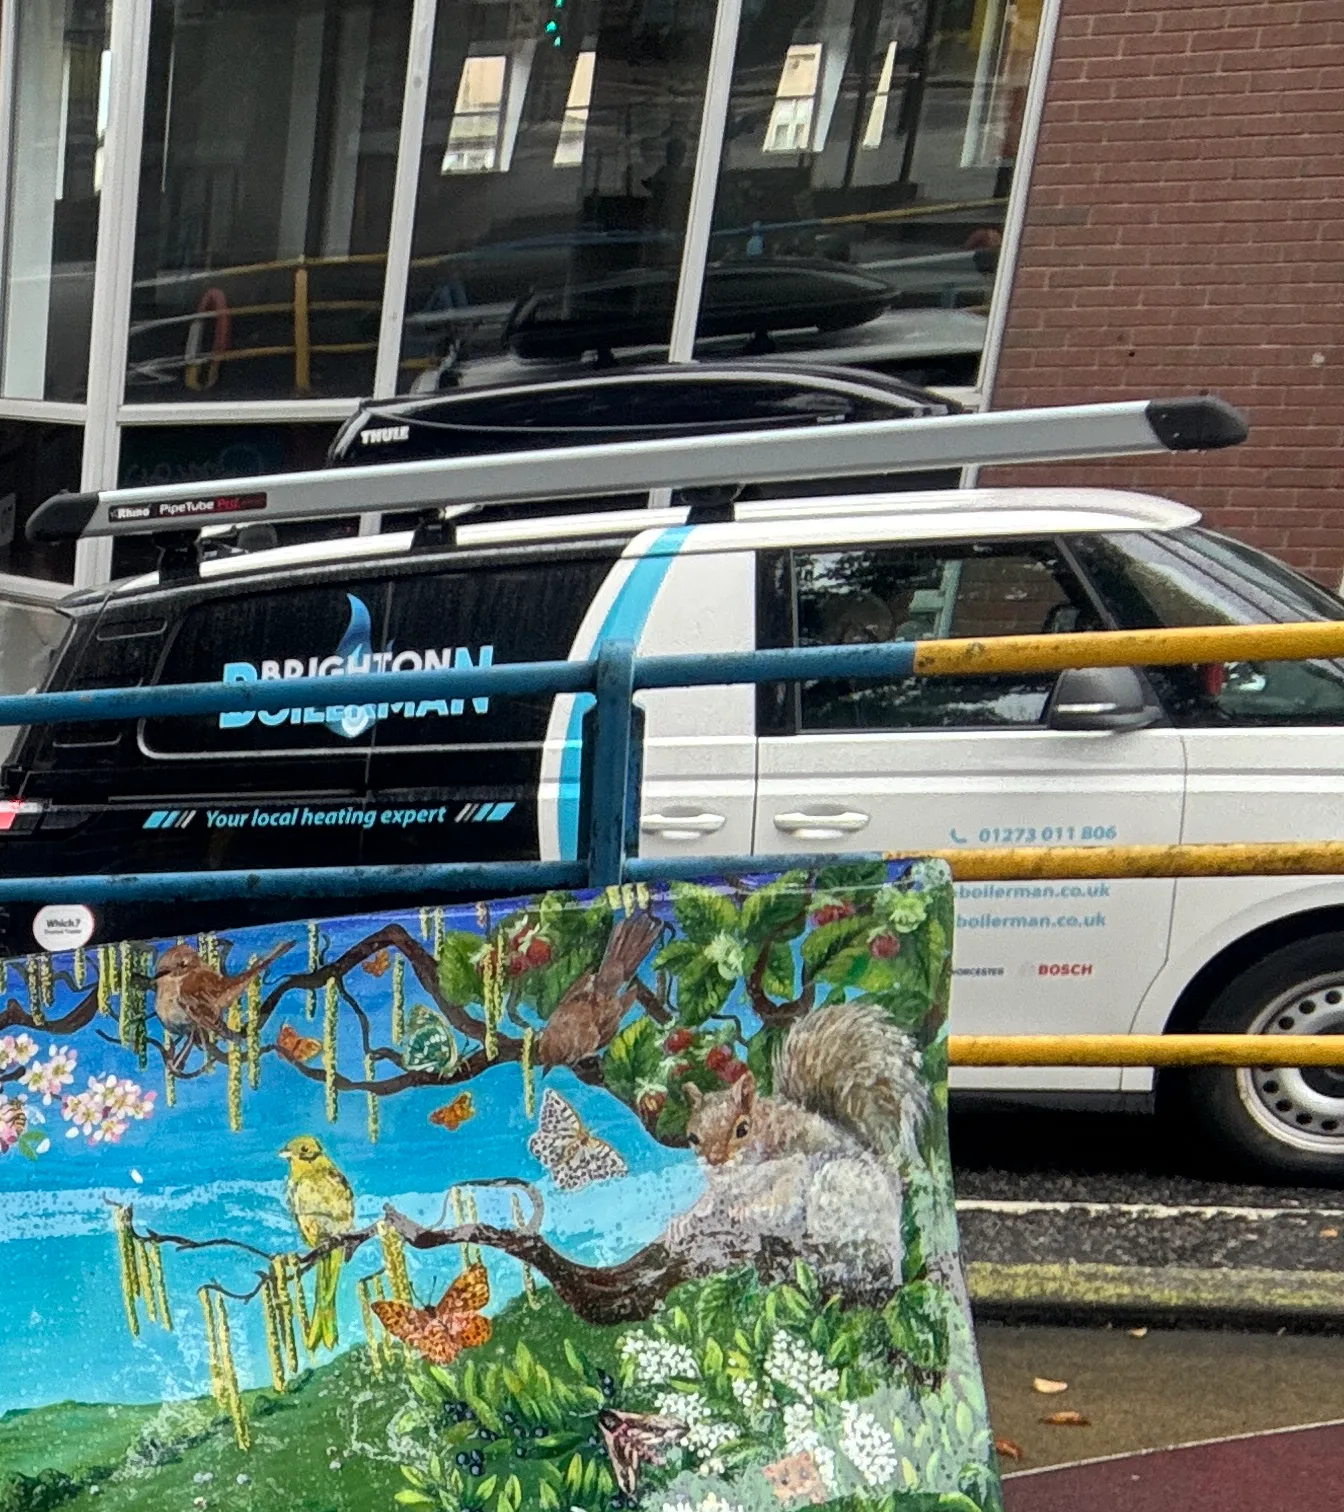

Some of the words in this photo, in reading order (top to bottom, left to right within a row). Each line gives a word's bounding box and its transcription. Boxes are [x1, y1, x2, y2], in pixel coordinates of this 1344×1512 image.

[360, 426, 410, 444] THULE
[117, 508, 150, 519] Rhino
[159, 501, 214, 515] PipeTube
[206, 810, 247, 828] Your
[251, 807, 297, 826] local
[302, 806, 376, 829] heating
[380, 805, 447, 827] expert
[978, 827, 1037, 843] 01273
[1041, 826, 1076, 842] 011
[1080, 825, 1118, 841] 806
[46, 918, 81, 928] Which?
[1038, 964, 1093, 976] BOSCH
